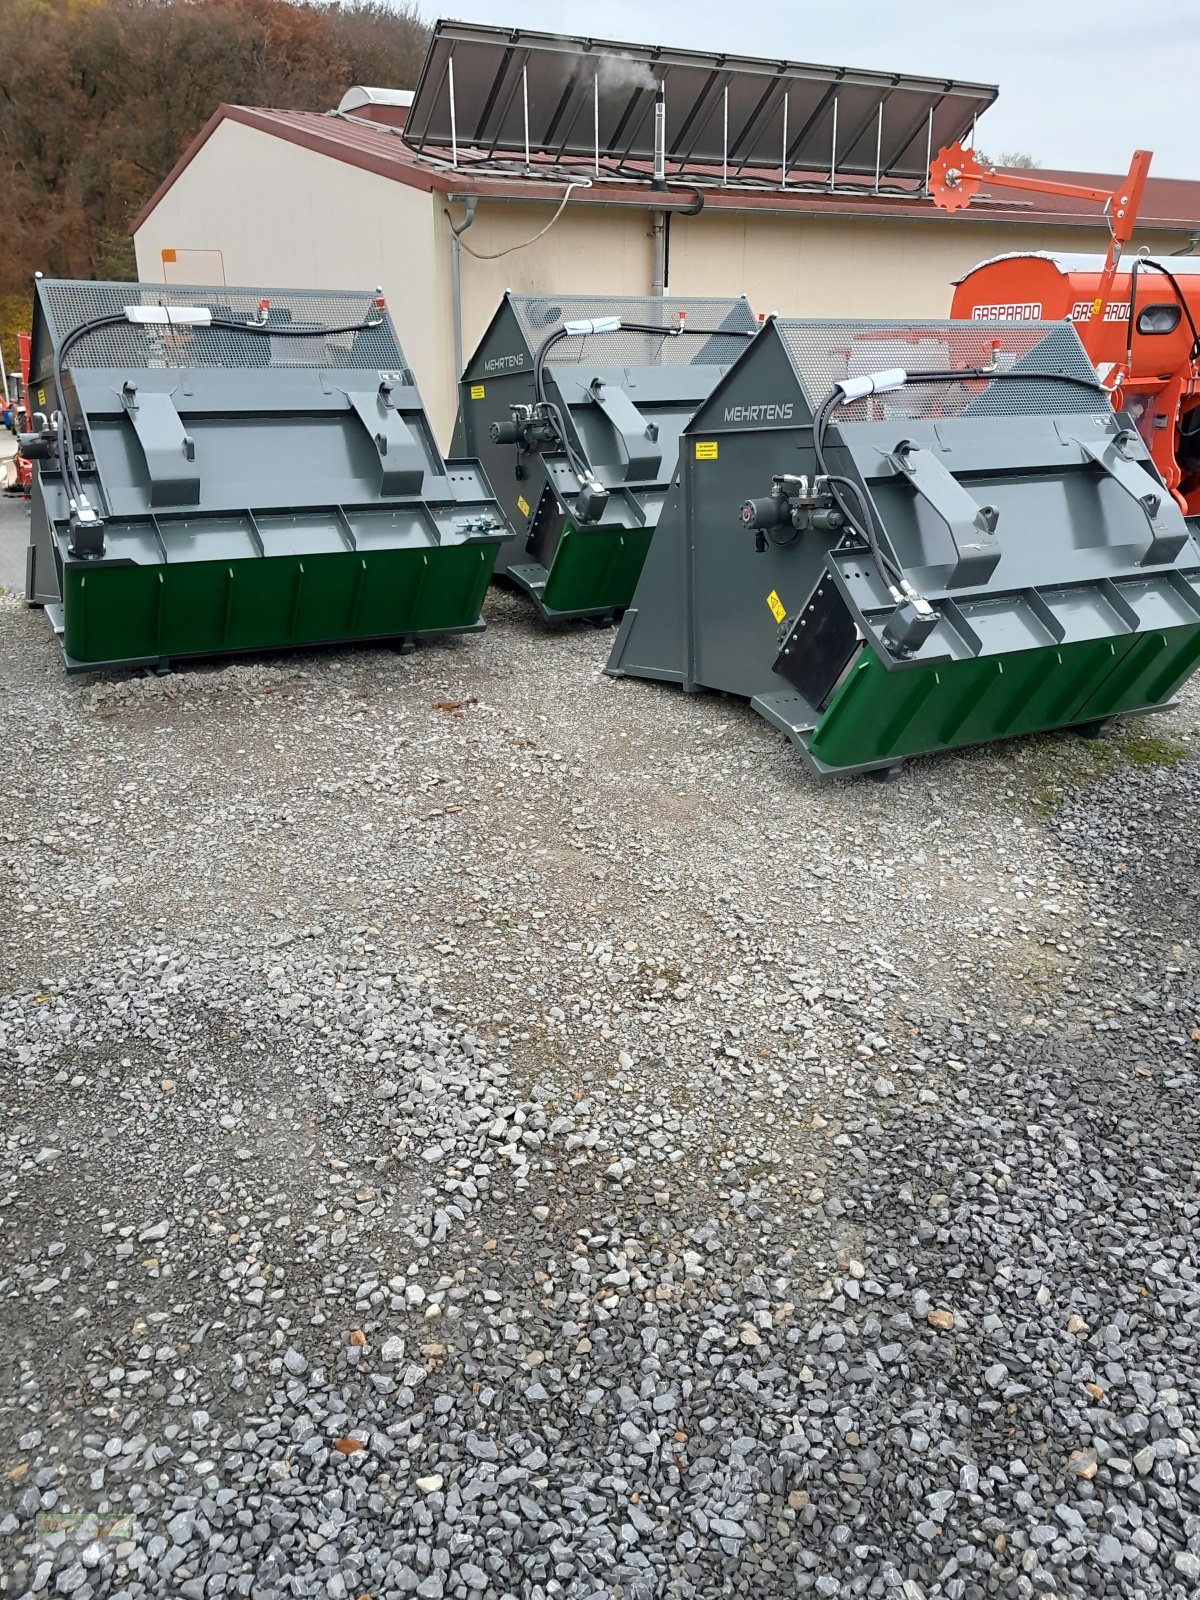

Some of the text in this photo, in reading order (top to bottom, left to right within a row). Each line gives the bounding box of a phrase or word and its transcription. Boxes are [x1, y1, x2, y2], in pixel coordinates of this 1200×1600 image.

[973, 304, 1041, 320] GASPARDO
[484, 353, 524, 371] MEHRTENS
[723, 403, 794, 422] MEHRTENS
